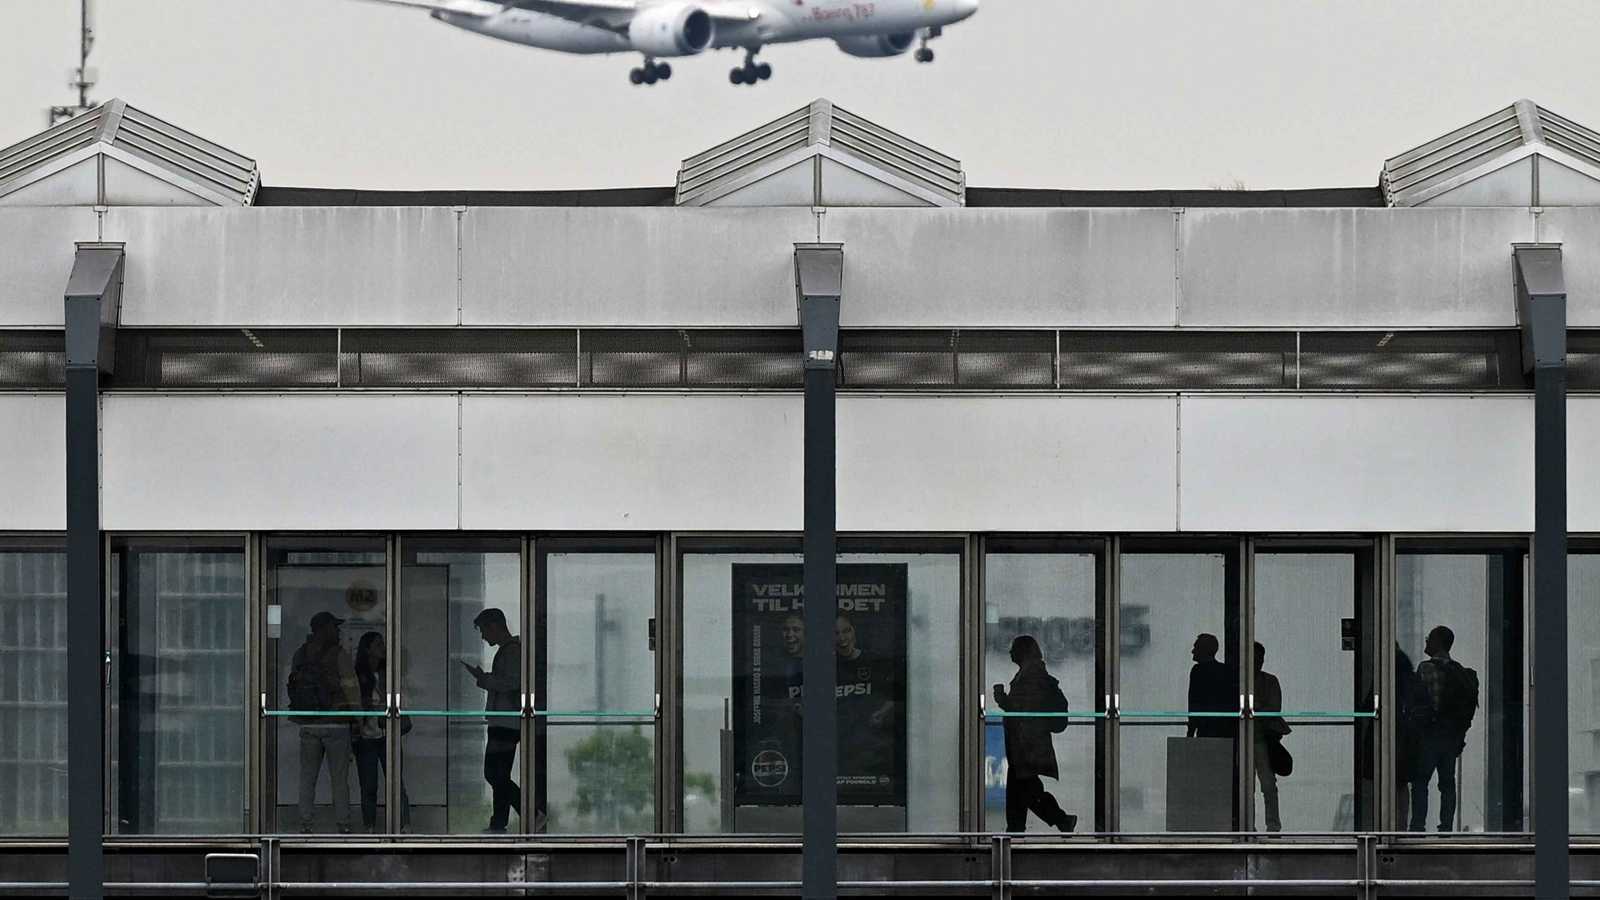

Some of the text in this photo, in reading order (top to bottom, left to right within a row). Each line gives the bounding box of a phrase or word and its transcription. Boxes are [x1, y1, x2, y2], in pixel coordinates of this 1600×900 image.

[752, 583, 886, 596] VELKMEN
[752, 598, 886, 611] TIL HDET
[834, 683, 872, 697] EPSI
